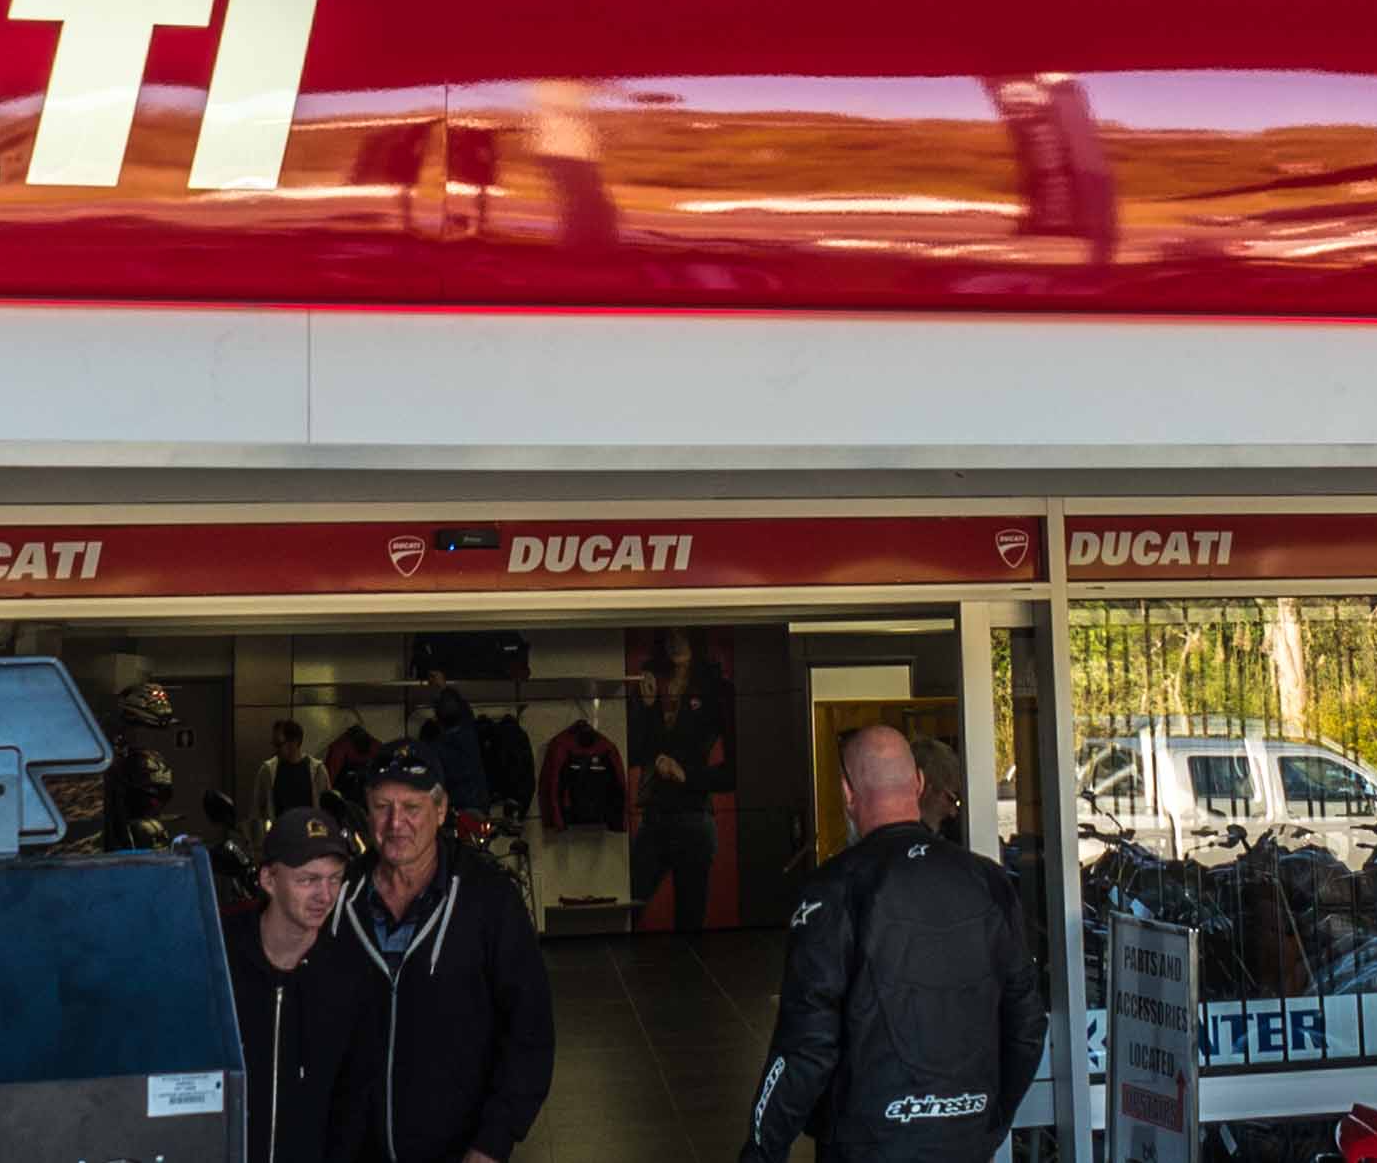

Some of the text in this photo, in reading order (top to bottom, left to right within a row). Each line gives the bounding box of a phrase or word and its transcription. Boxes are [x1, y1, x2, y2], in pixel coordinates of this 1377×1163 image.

[508, 535, 693, 573] DUCATI
[1069, 531, 1233, 566] DUCATI
[1124, 945, 1182, 982] PARTS AND
[1116, 990, 1188, 1034] ACCESSORIES
[1199, 1009, 1329, 1057] NTER
[1129, 1041, 1175, 1078] LOCATED
[885, 1093, 988, 1122] alpinestars
